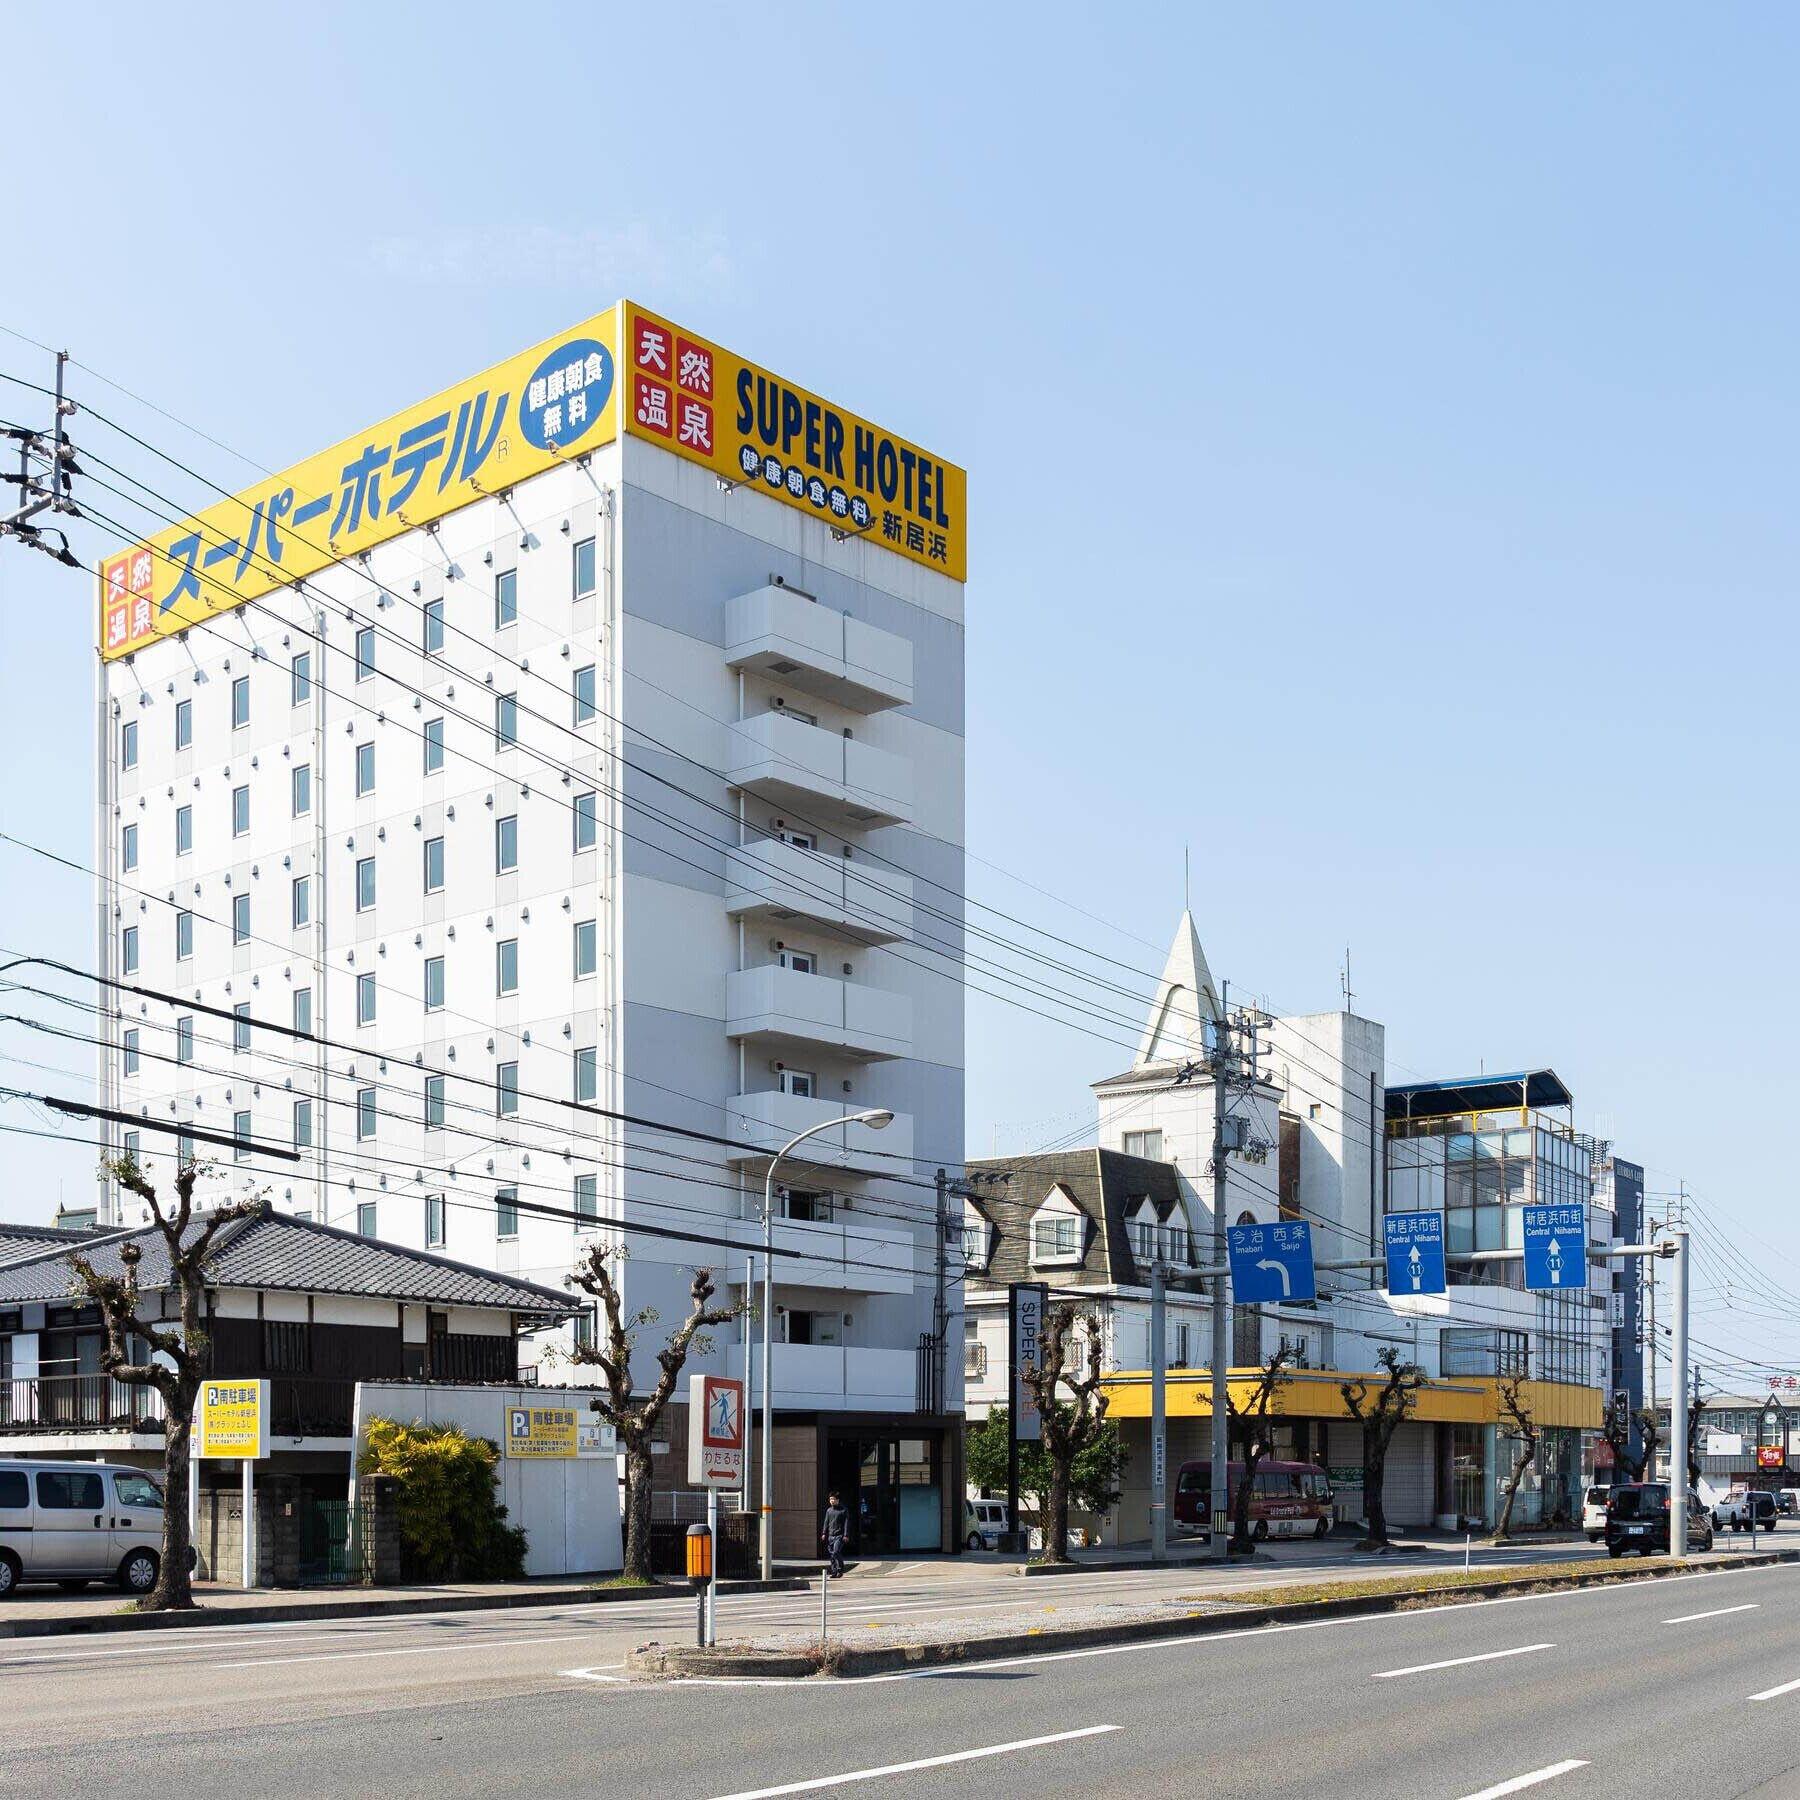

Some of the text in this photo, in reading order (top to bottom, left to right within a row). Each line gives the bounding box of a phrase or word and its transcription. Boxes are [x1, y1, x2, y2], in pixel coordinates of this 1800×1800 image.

[641, 331, 709, 393] 天然
[529, 352, 603, 412] 健康朝食
[544, 391, 587, 438] 無料
[638, 384, 711, 449] 温泉
[737, 368, 949, 529] SUPER HOTEL
[743, 448, 868, 525] 健康朝食無料
[159, 390, 509, 616] スーパーホテル
[882, 510, 947, 564] 新居浜
[109, 553, 152, 602] 天然
[108, 599, 152, 647] 温泉
[1387, 1217, 1439, 1234] 新居浜市街
[1526, 1209, 1581, 1226] 新居浜市街
[1232, 1225, 1306, 1245] 今治 西条
[1387, 1234, 1440, 1244] Central Niihama
[1526, 1227, 1582, 1237] Central Niihama
[1235, 1242, 1300, 1254] Imabari Saijo
[1410, 1264, 1421, 1275] 11
[1550, 1257, 1561, 1268] 11
[1022, 1302, 1035, 1361] SUPER
[1769, 1375, 1800, 1389] 安全
[220, 1388, 256, 1404] 南駐車場
[513, 1412, 526, 1436] P
[533, 1411, 574, 1426] 南駐車場
[704, 1452, 741, 1465] わたるな
